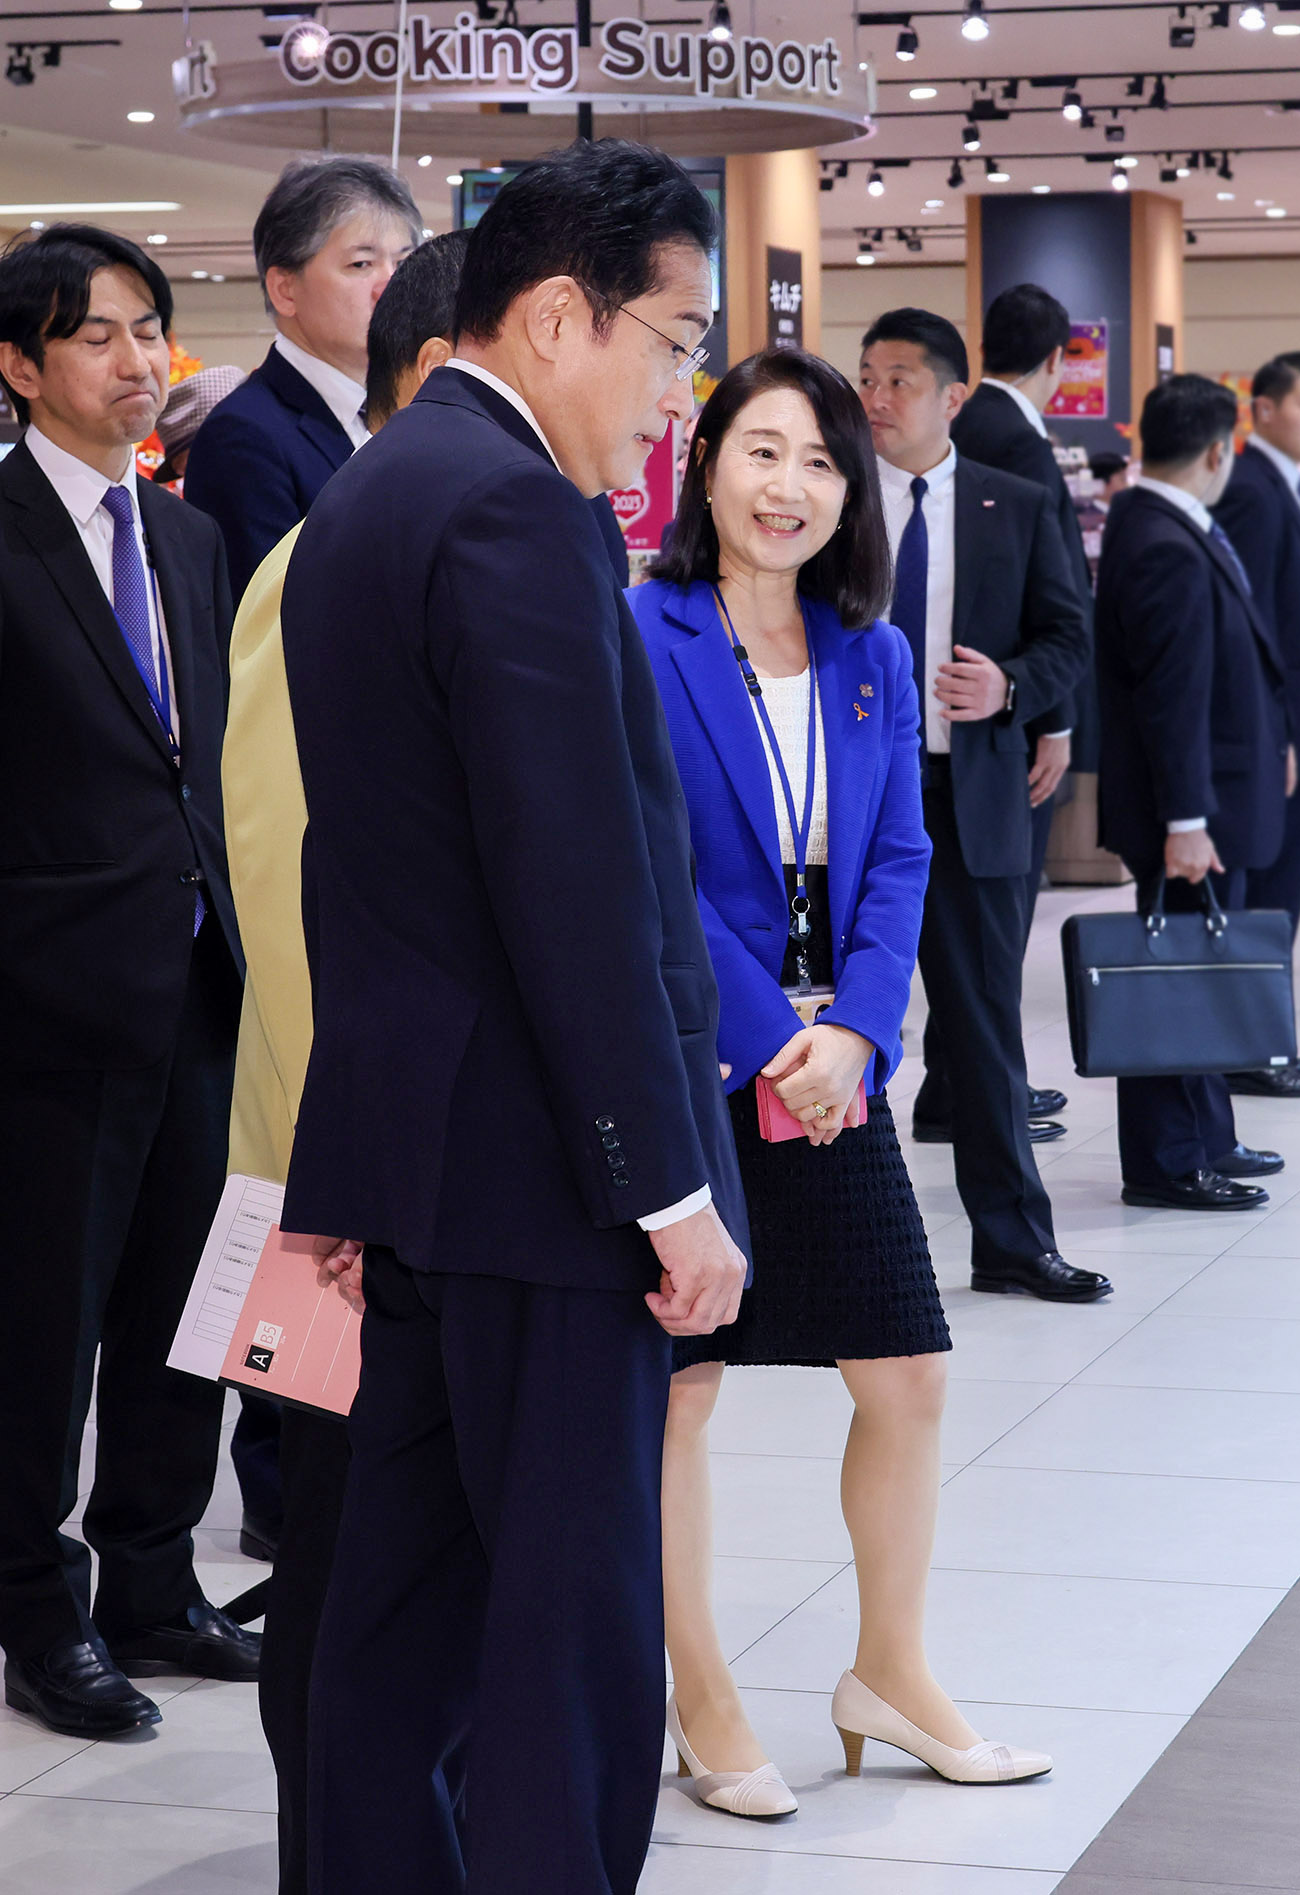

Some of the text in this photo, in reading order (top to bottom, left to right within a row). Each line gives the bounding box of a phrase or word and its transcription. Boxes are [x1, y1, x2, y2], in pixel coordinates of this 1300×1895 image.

[281, 14, 840, 97] Cooking Support
[259, 1325, 278, 1345] B5
[251, 1354, 270, 1368] A
